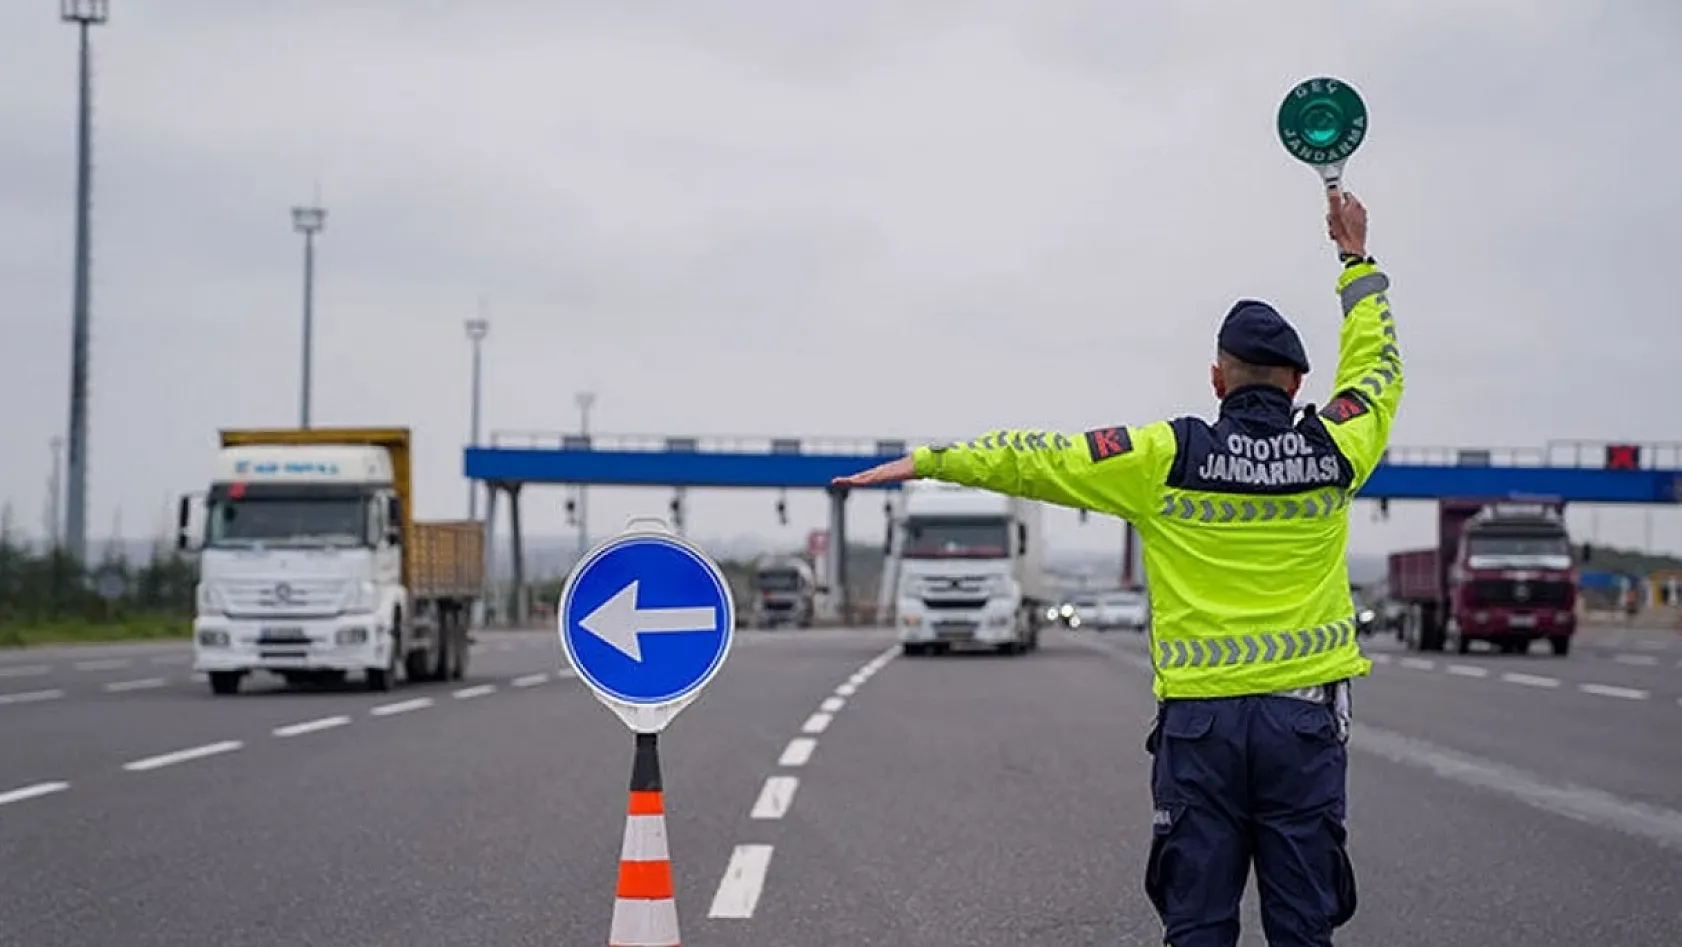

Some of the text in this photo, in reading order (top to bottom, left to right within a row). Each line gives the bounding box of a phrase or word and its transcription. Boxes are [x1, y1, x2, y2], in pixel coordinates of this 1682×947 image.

[1295, 80, 1338, 99] GEÇ
[1283, 115, 1365, 161] JANDARMA
[1227, 432, 1313, 461] OTOYOL
[1199, 454, 1339, 485] JANDARMASI
